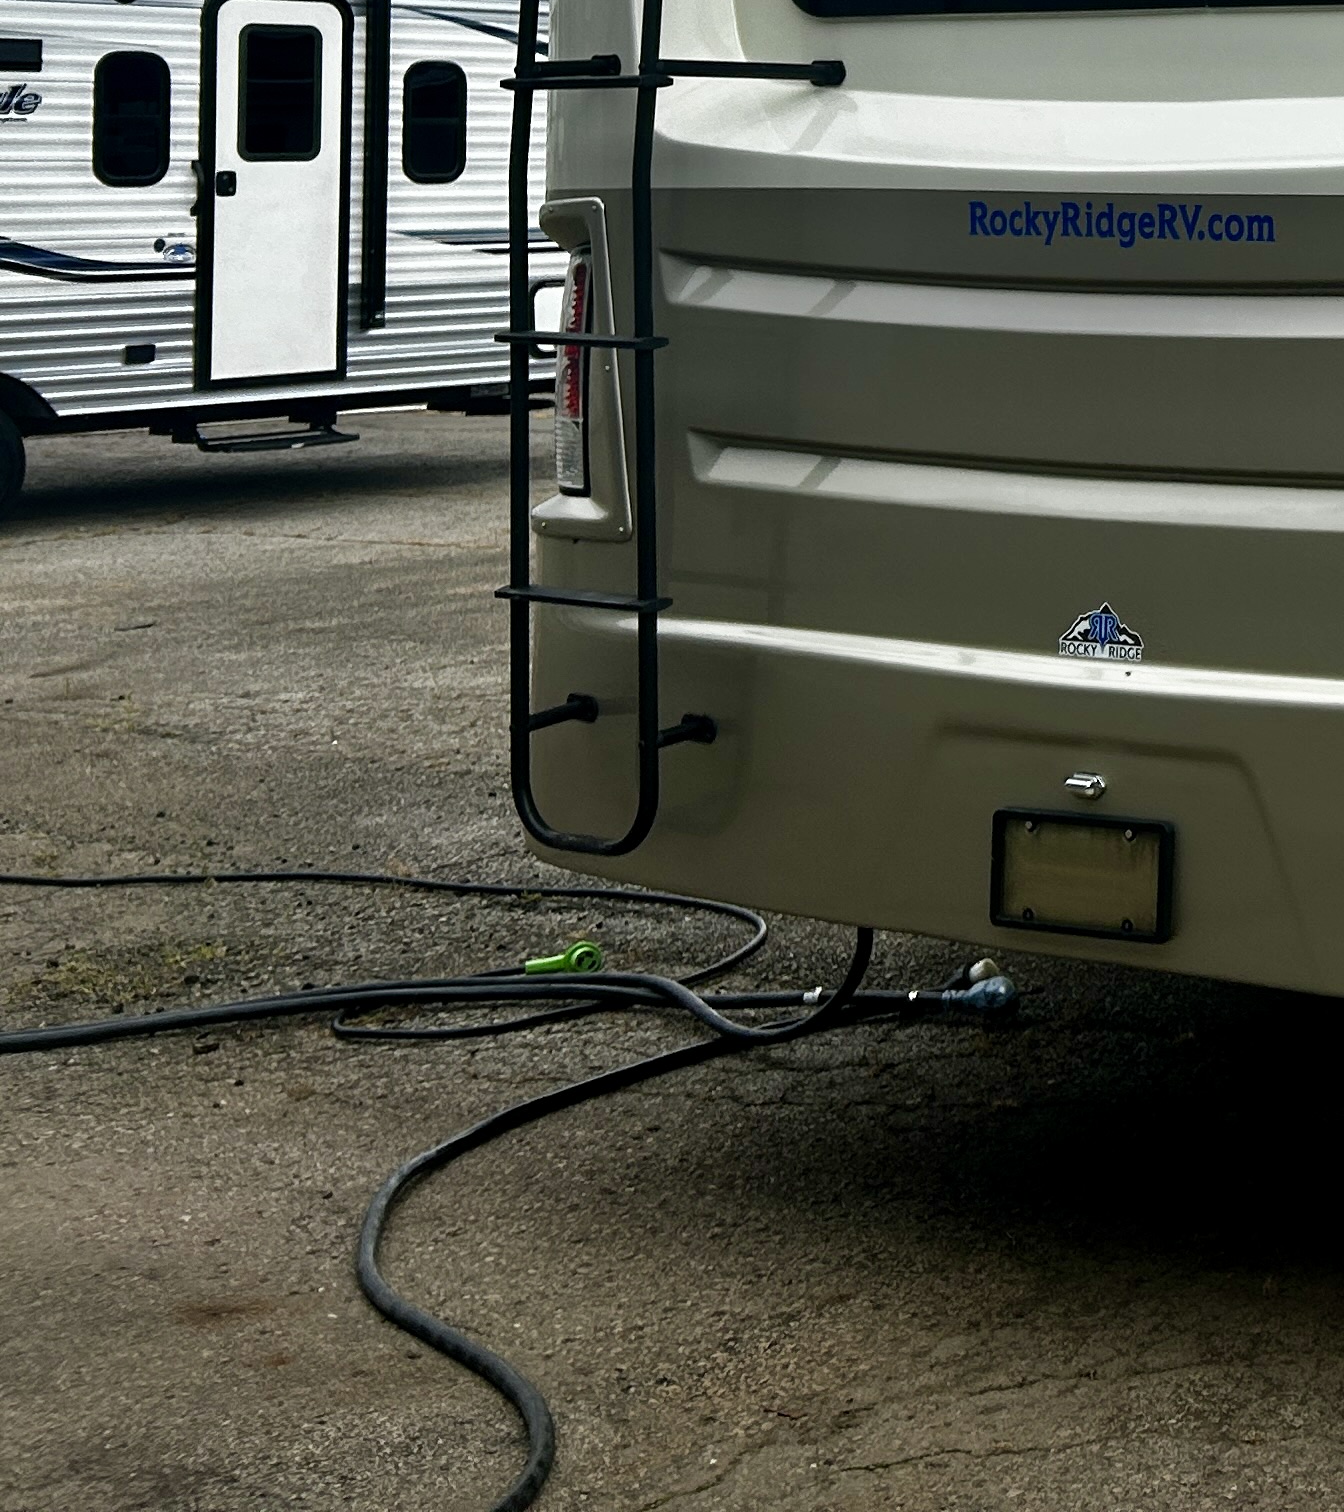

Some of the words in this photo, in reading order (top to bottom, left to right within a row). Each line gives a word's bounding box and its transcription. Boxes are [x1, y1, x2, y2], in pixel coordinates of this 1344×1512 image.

[969, 200, 1276, 248] RockyRidgeRV.com
[1061, 642, 1097, 656] ROCKY
[1109, 646, 1141, 660] RIDGE
